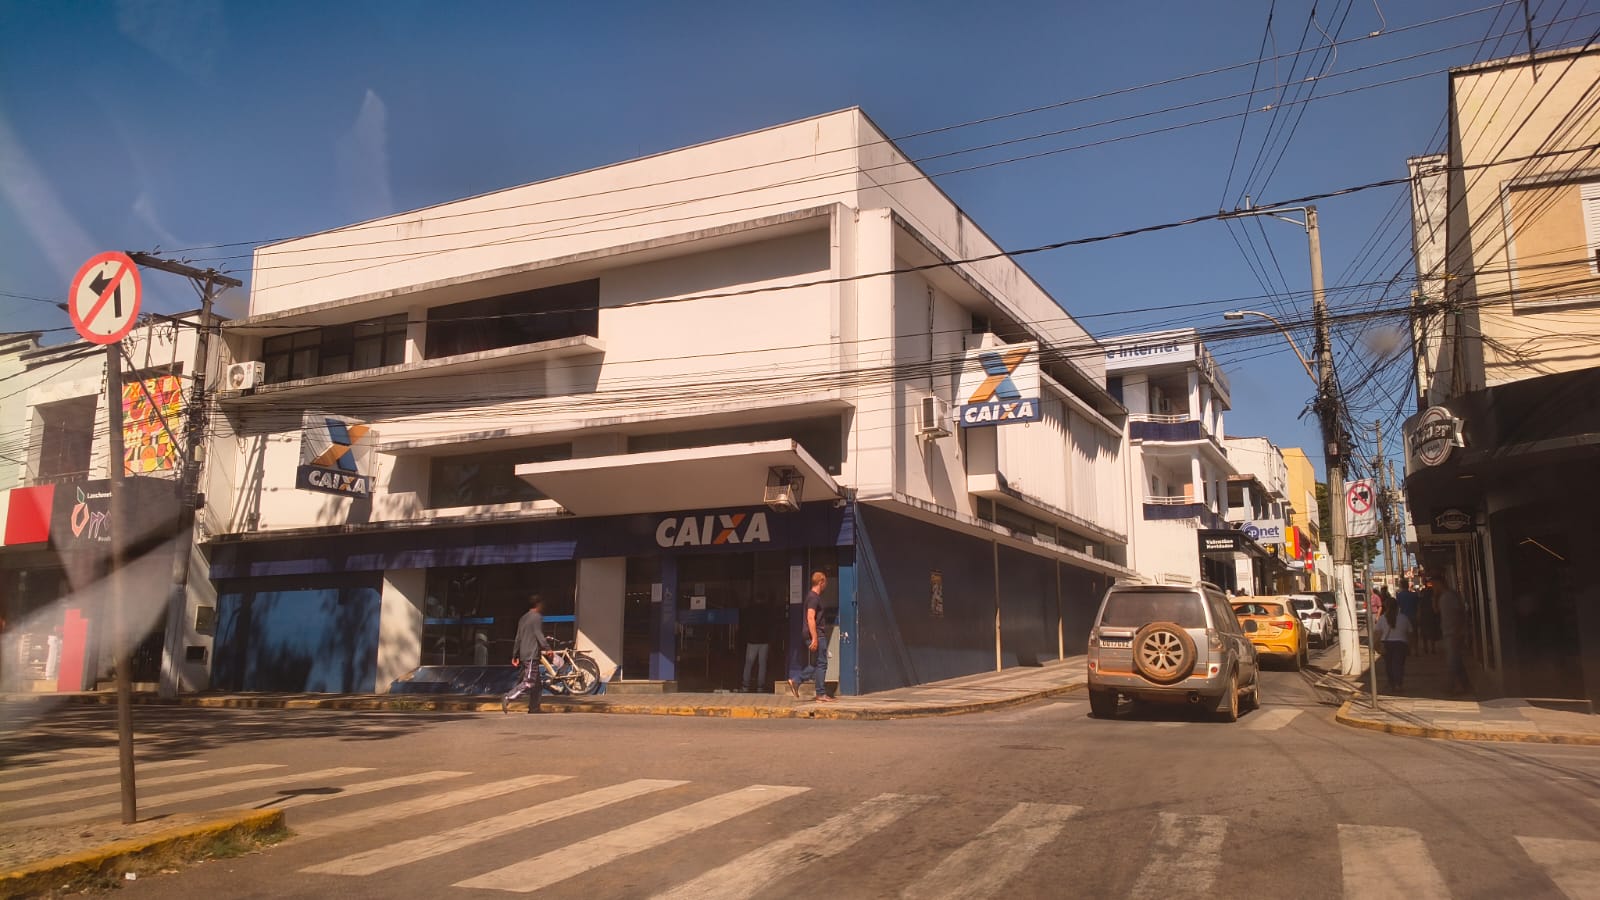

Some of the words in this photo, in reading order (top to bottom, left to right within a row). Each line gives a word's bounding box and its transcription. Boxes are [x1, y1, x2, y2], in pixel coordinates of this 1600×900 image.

[1119, 340, 1179, 358] internet
[964, 401, 1033, 423] CAIXA
[308, 470, 366, 494] CAIXA
[87, 491, 112, 499] Lanchonet
[655, 512, 770, 548] CAIXA
